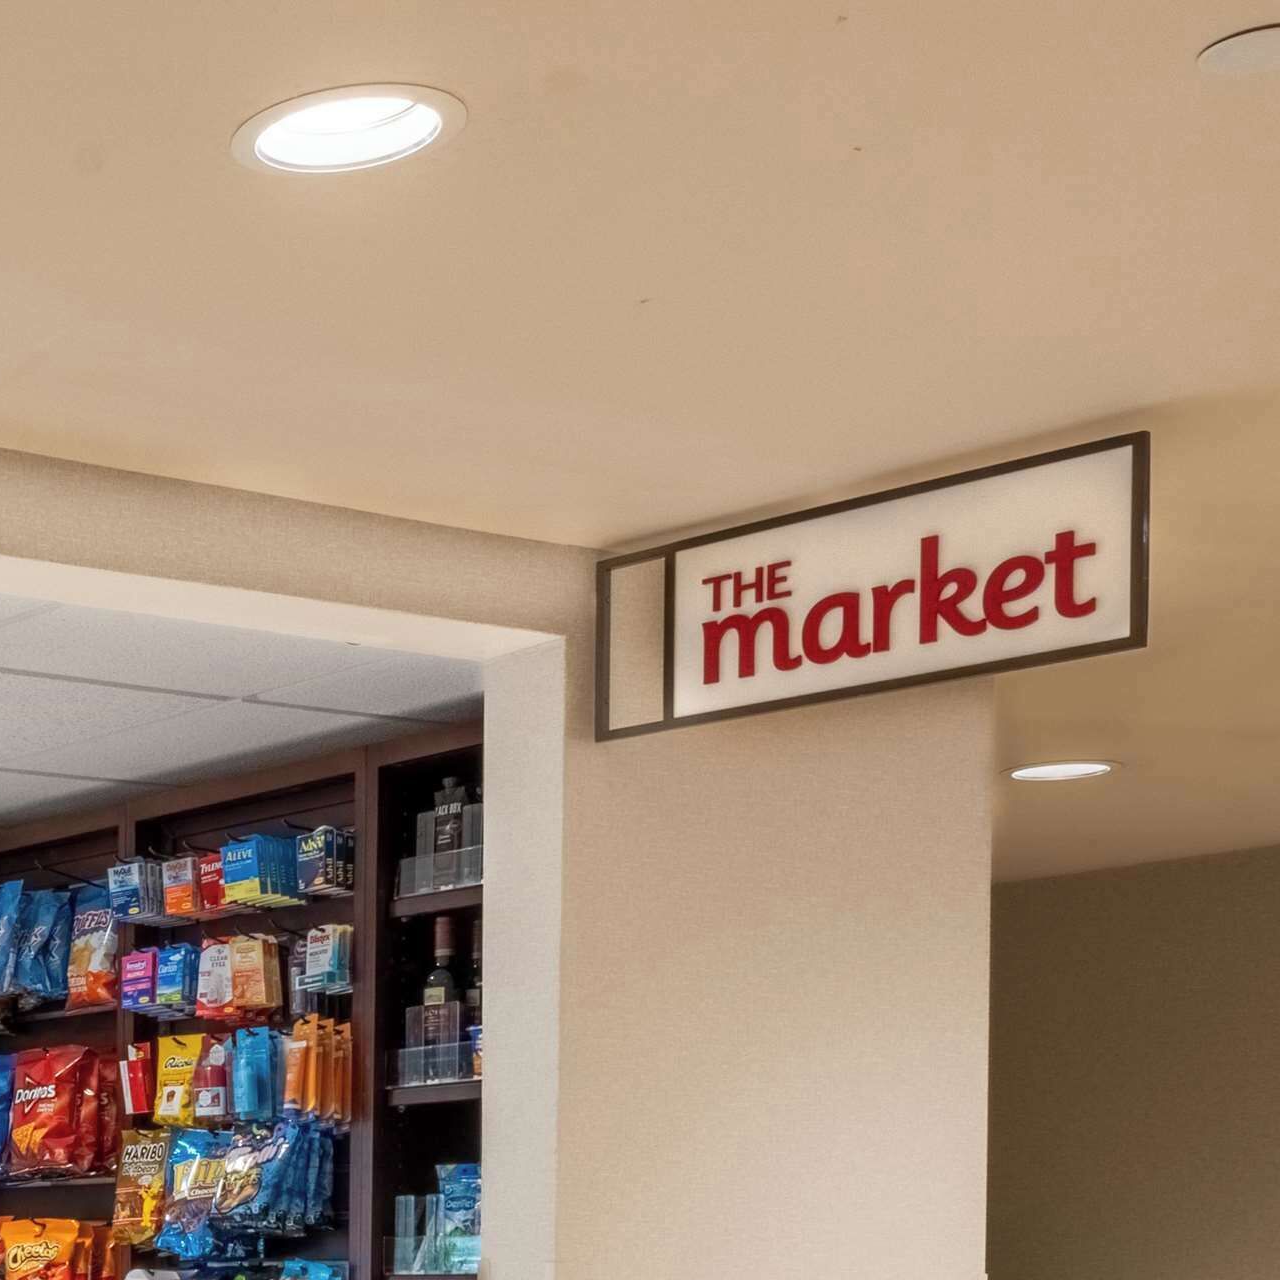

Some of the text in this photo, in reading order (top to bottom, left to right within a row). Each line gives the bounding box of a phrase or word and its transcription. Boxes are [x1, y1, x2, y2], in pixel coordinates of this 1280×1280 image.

[702, 560, 792, 612] THE
[701, 530, 1097, 685] market
[226, 849, 253, 861] ALEVE
[200, 861, 222, 874] TYLEN
[15, 1084, 57, 1105] Doritos
[122, 1141, 166, 1163] HARIBO
[7, 1242, 60, 1271] Cheetos
